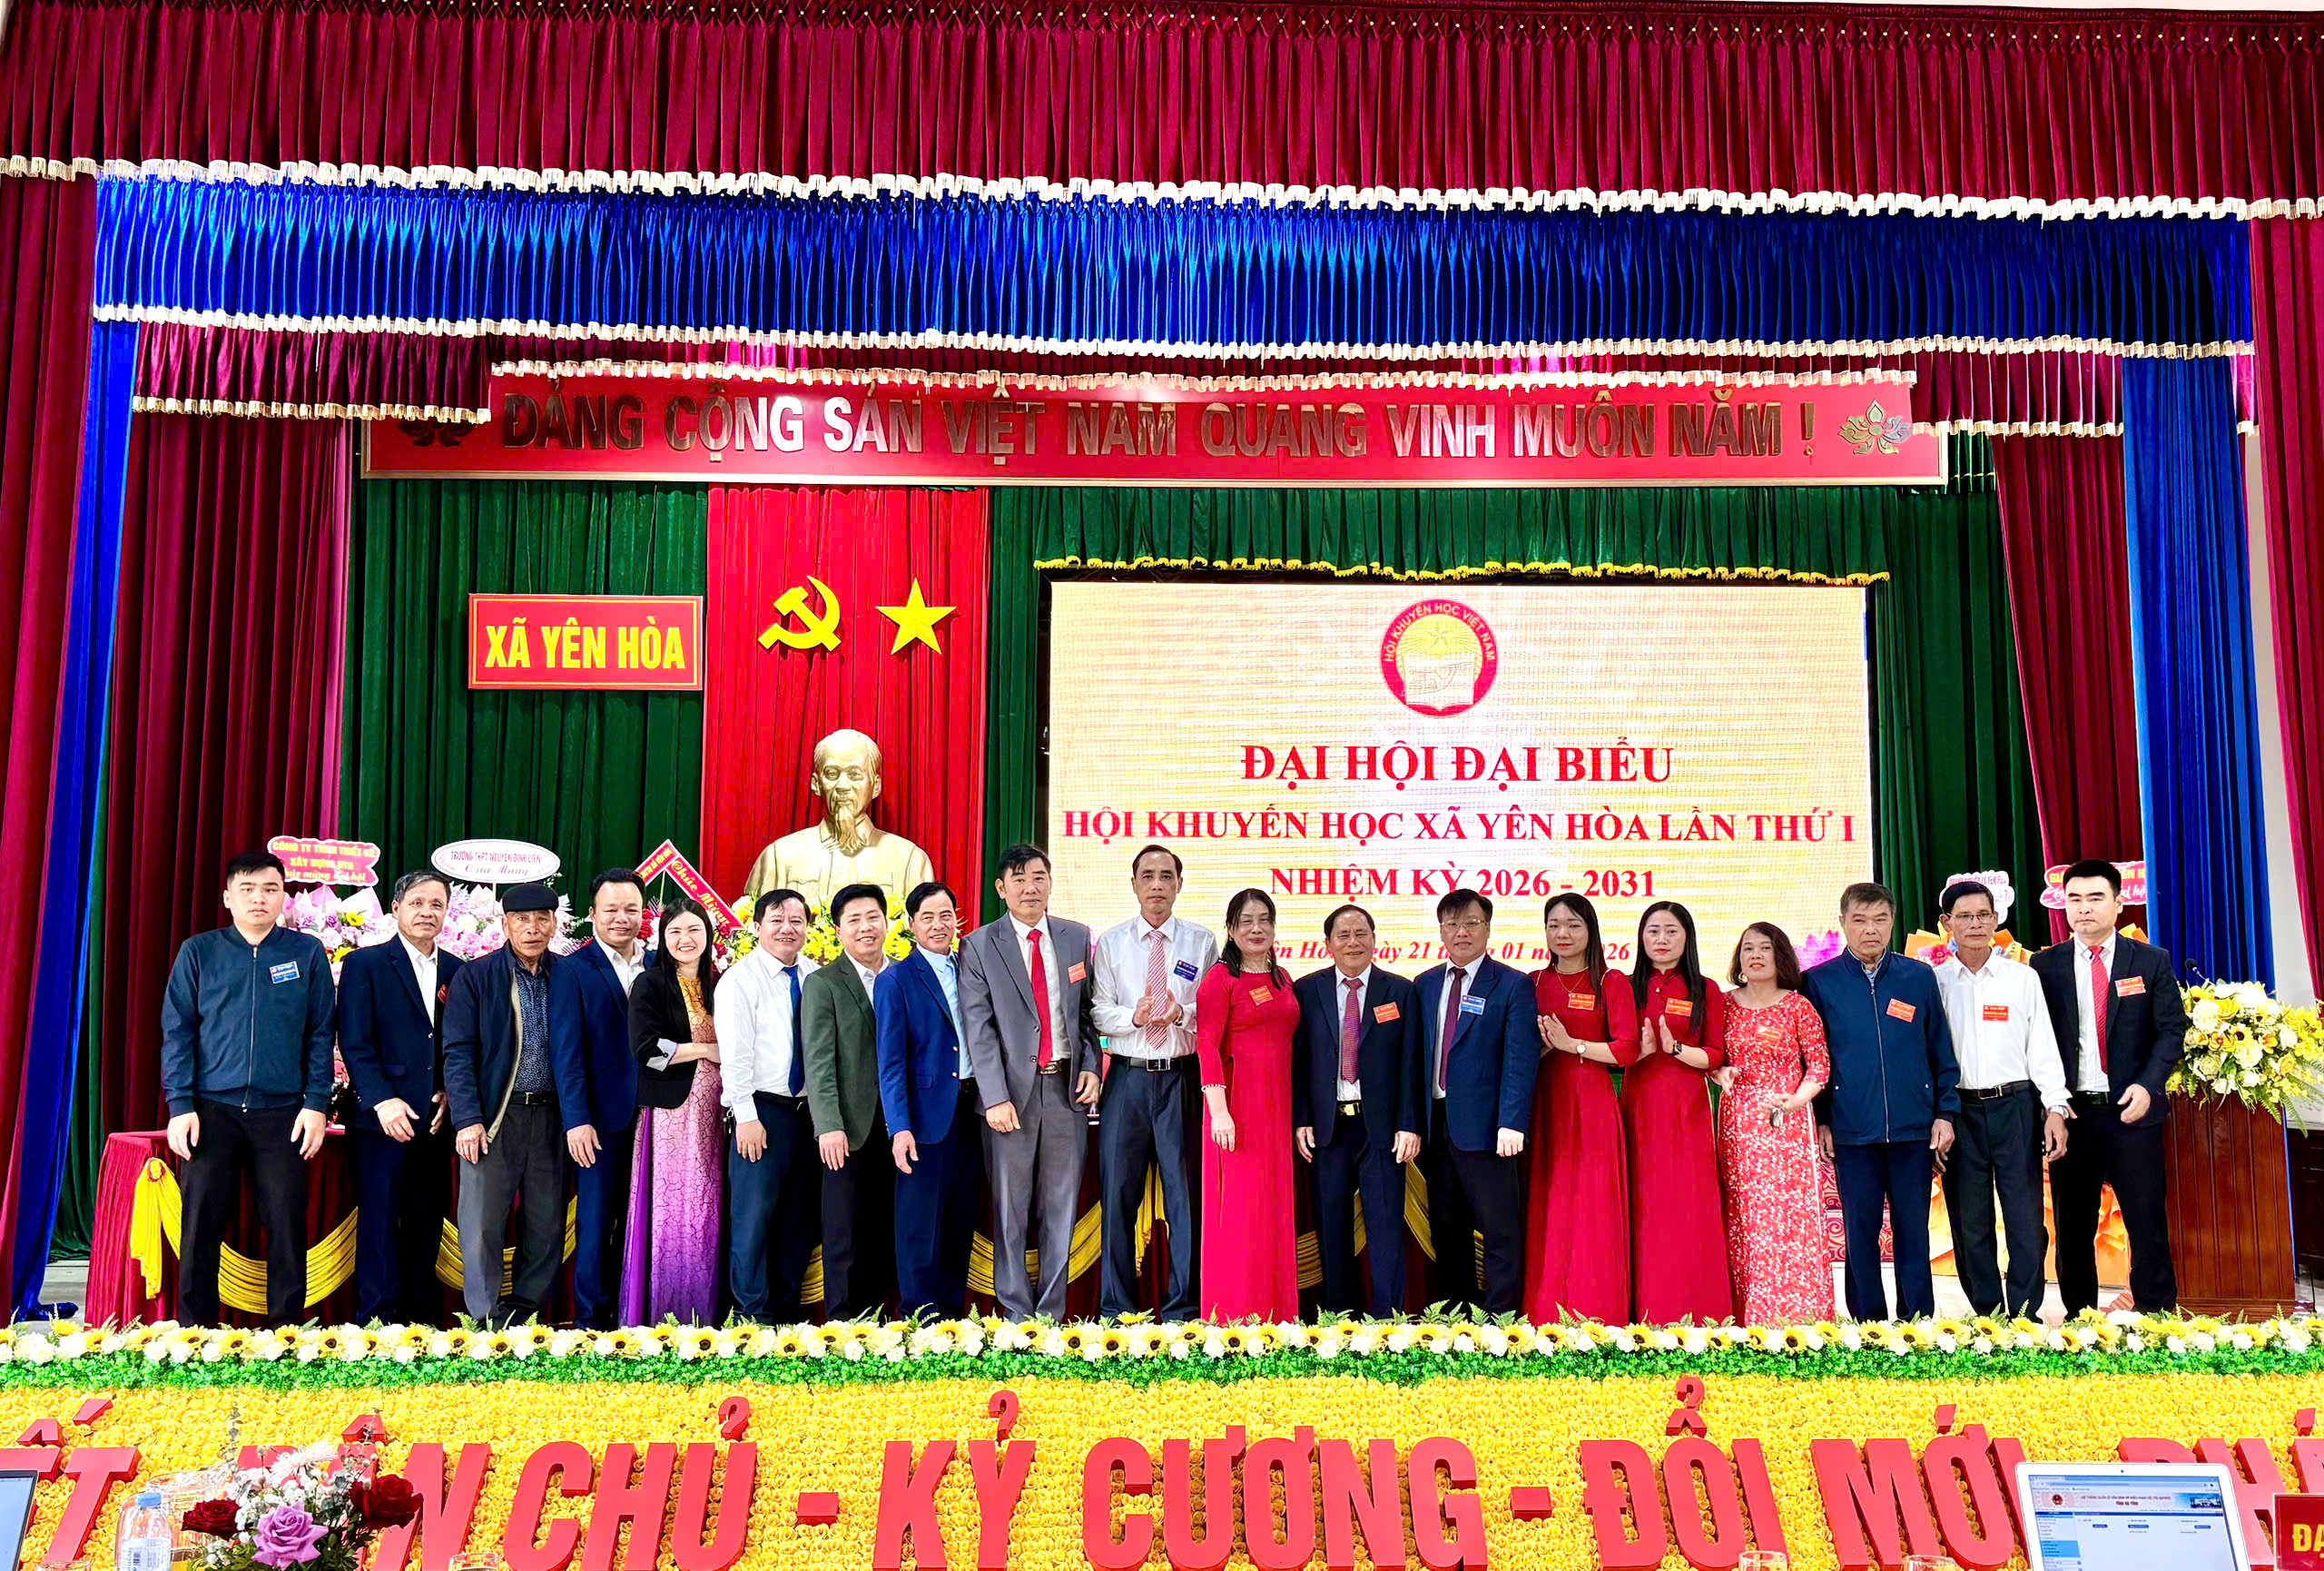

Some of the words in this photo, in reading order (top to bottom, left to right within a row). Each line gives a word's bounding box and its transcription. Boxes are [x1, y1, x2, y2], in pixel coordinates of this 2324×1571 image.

[665, 382, 805, 463] CỘNG
[822, 380, 923, 453] SẢN
[940, 386, 1046, 466] VIỆT
[1067, 400, 1177, 456] NAM
[1200, 401, 1368, 458] QUANG
[1385, 403, 1496, 458] VINH
[1512, 390, 1656, 458] MUÔN
[1672, 389, 1783, 458] NĂM
[485, 616, 531, 668] XÃ
[541, 617, 606, 669] YÊN
[617, 615, 686, 669] HÒA
[1481, 632, 1496, 662] NAM
[1241, 746, 1330, 790] ĐẠI
[1343, 740, 1440, 791] HỘI
[1452, 746, 1541, 792] ĐẠI
[1554, 736, 1674, 783] BIỂU
[1062, 805, 1134, 845] HỘI
[1147, 803, 1307, 839] KHUYẾN
[1322, 811, 1403, 846] HỌC
[1416, 805, 1471, 840] XÃ
[1477, 805, 1553, 841] YÊN
[1566, 805, 1650, 842] HÒA
[1659, 805, 1742, 842] LẦN
[1748, 805, 1835, 843] THỨ
[1840, 815, 1856, 842] I
[1271, 862, 1403, 903] NHIỆM
[1412, 860, 1467, 896] KỲ
[1476, 868, 1551, 897] 2026
[1583, 869, 1656, 897] 2031
[1408, 941, 1431, 960] 21
[1502, 942, 1525, 960] 01
[504, 1395, 759, 1571] CHỦ
[872, 1389, 1037, 1571] KỶ
[1082, 1424, 1489, 1571] CƯƠNG
[1580, 1375, 1789, 1571] ĐỔI
